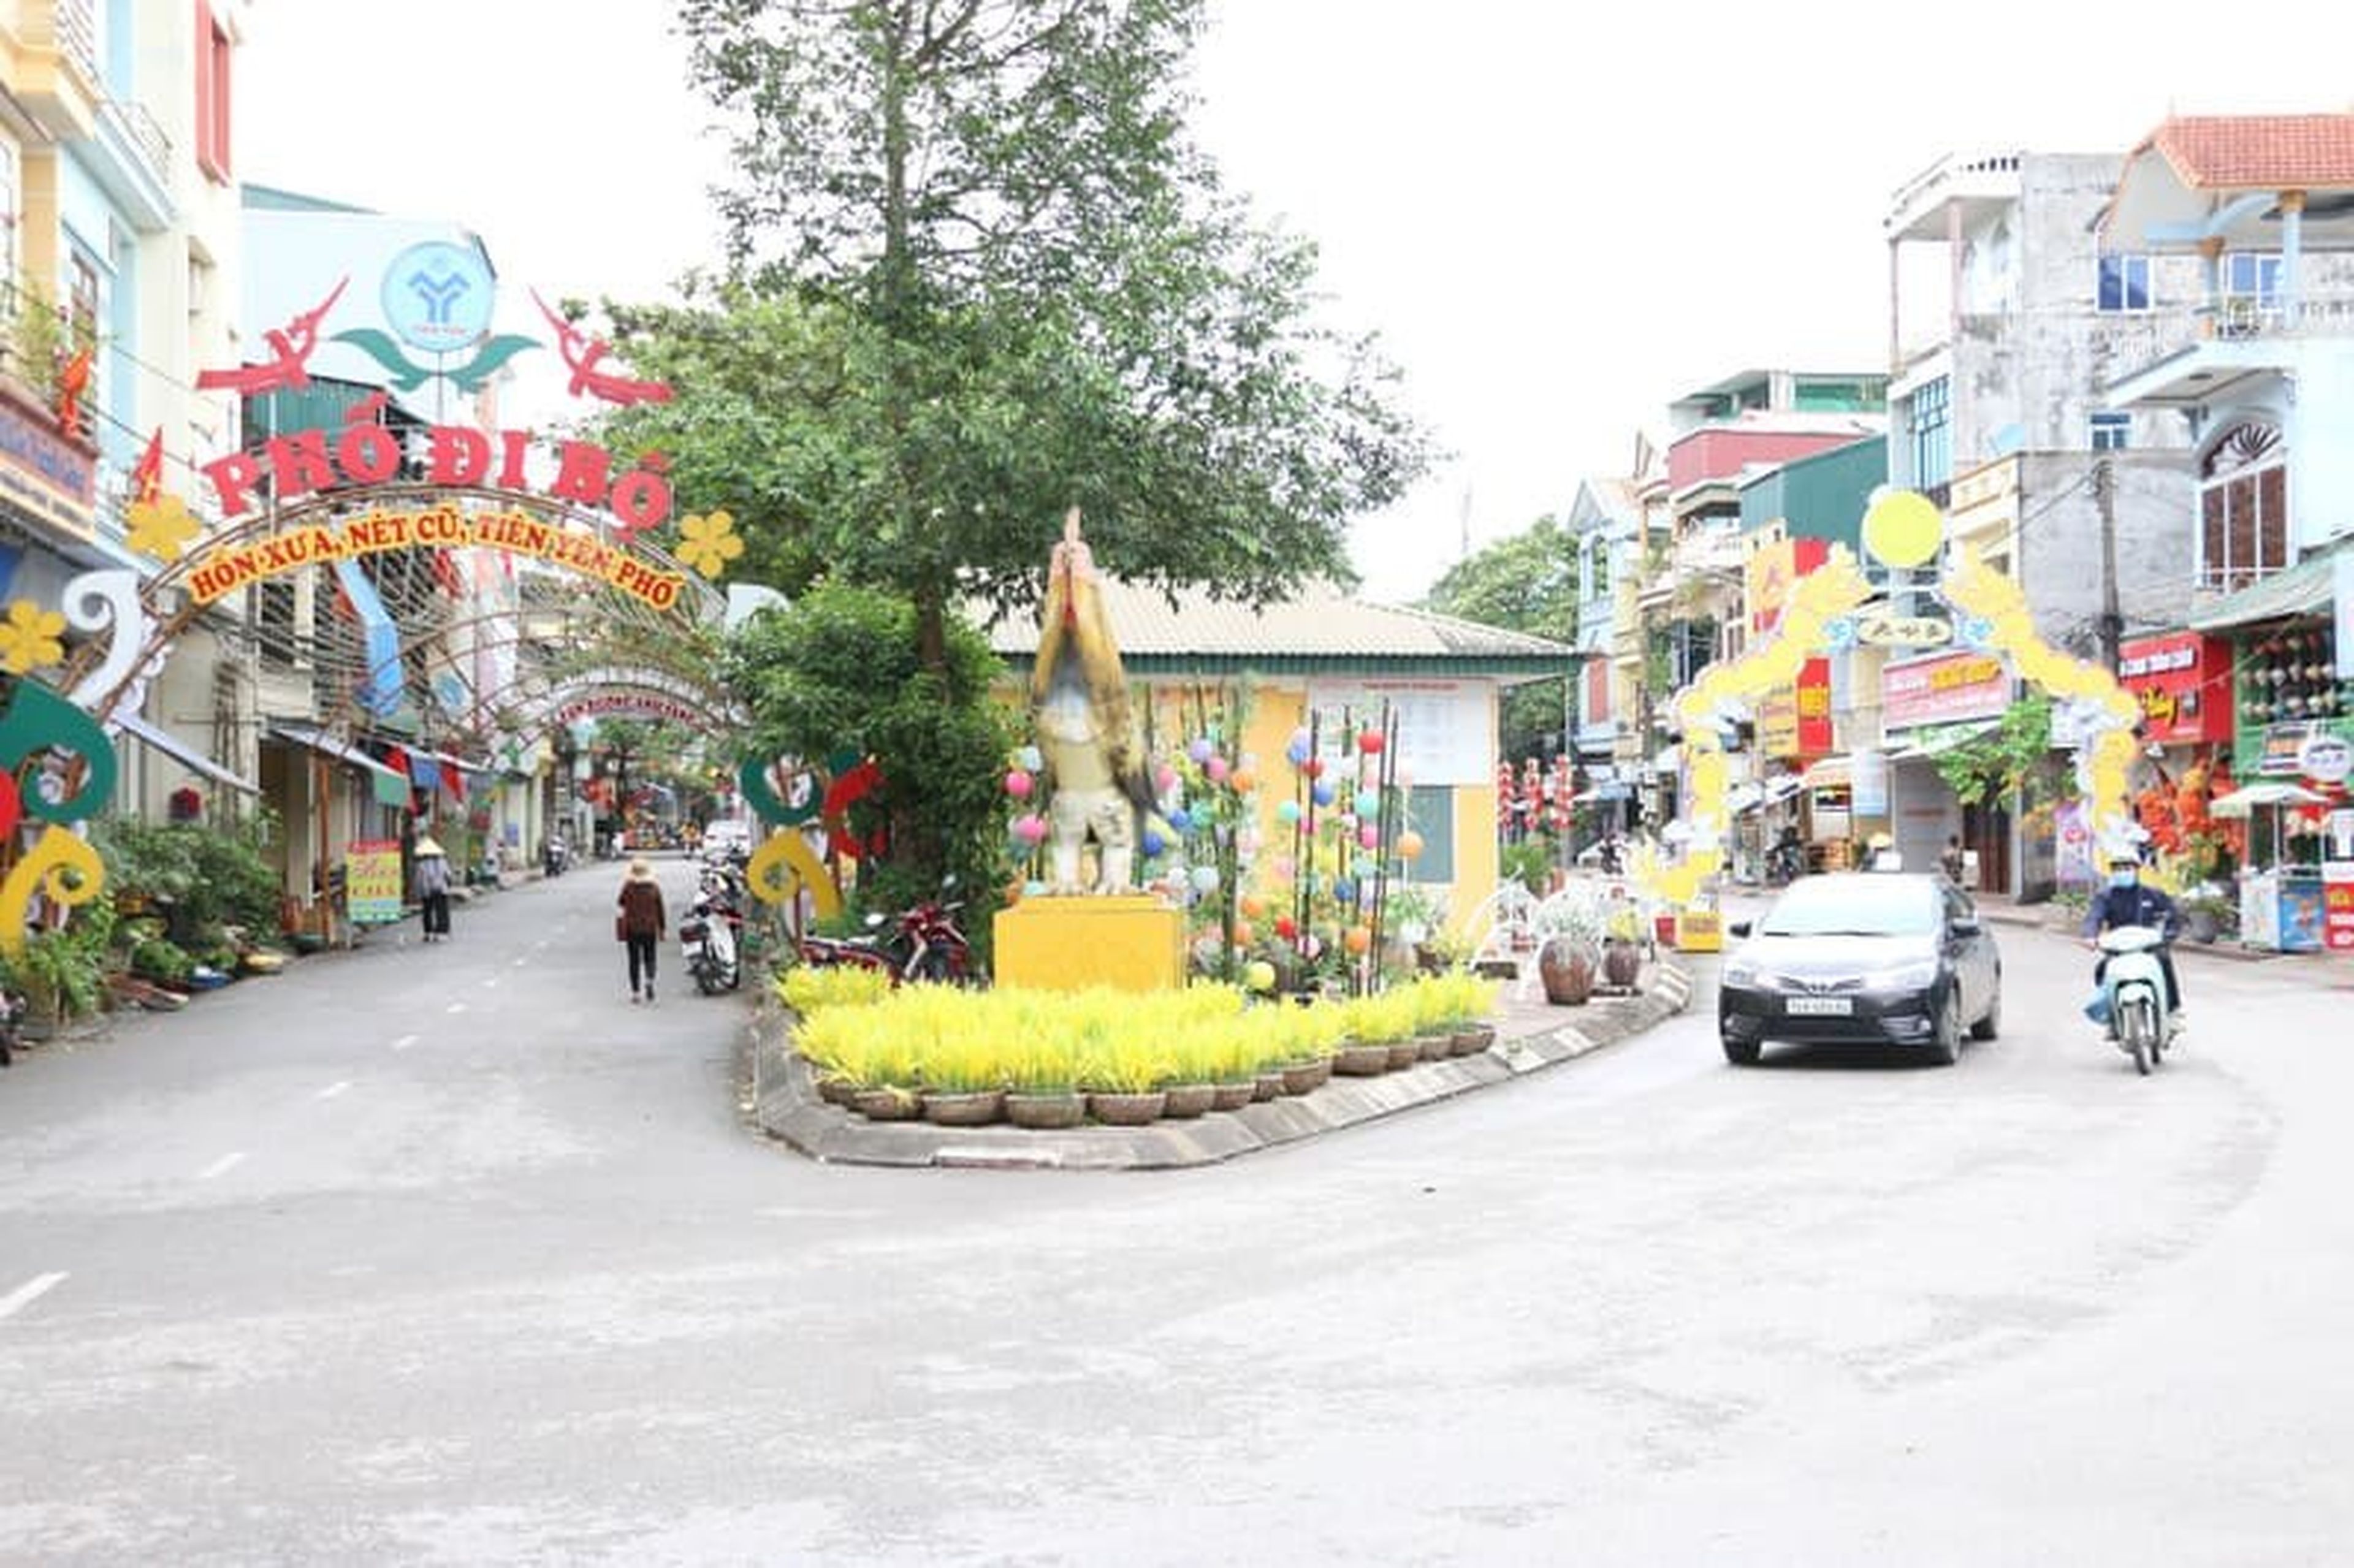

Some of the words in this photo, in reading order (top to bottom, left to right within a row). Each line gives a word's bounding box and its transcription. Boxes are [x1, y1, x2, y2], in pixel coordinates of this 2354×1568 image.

[201, 390, 401, 517] PHỐ
[427, 425, 534, 489] ĐI
[554, 440, 672, 545] BỘ
[349, 512, 406, 548] NÉT
[477, 512, 547, 551] TIÊN
[555, 531, 613, 572] YÊN
[616, 561, 685, 606] PHỐ
